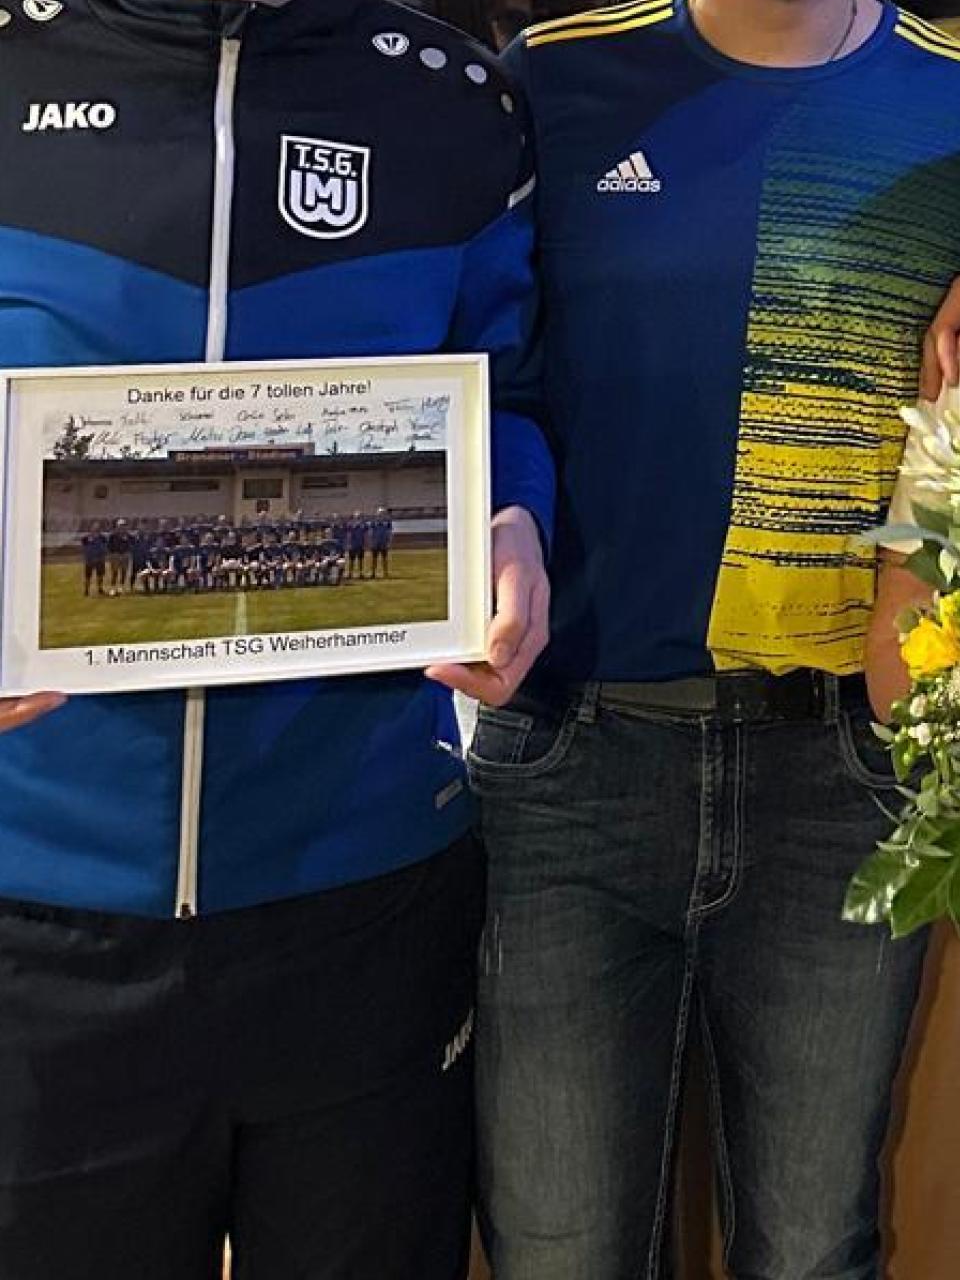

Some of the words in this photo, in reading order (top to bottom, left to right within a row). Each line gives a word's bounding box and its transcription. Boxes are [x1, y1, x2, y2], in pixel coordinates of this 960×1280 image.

[22, 102, 117, 132] JAKO
[596, 176, 661, 193] adidas
[127, 386, 185, 405] Danke
[190, 385, 214, 402] für
[218, 385, 245, 401] die
[250, 383, 262, 399] 7
[267, 383, 314, 398] tollen
[318, 380, 372, 397] Jahre!
[85, 649, 101, 666] 1.
[106, 640, 216, 665] Mannschaft
[221, 636, 264, 655] TSG
[269, 630, 408, 652] Weiherhammer
